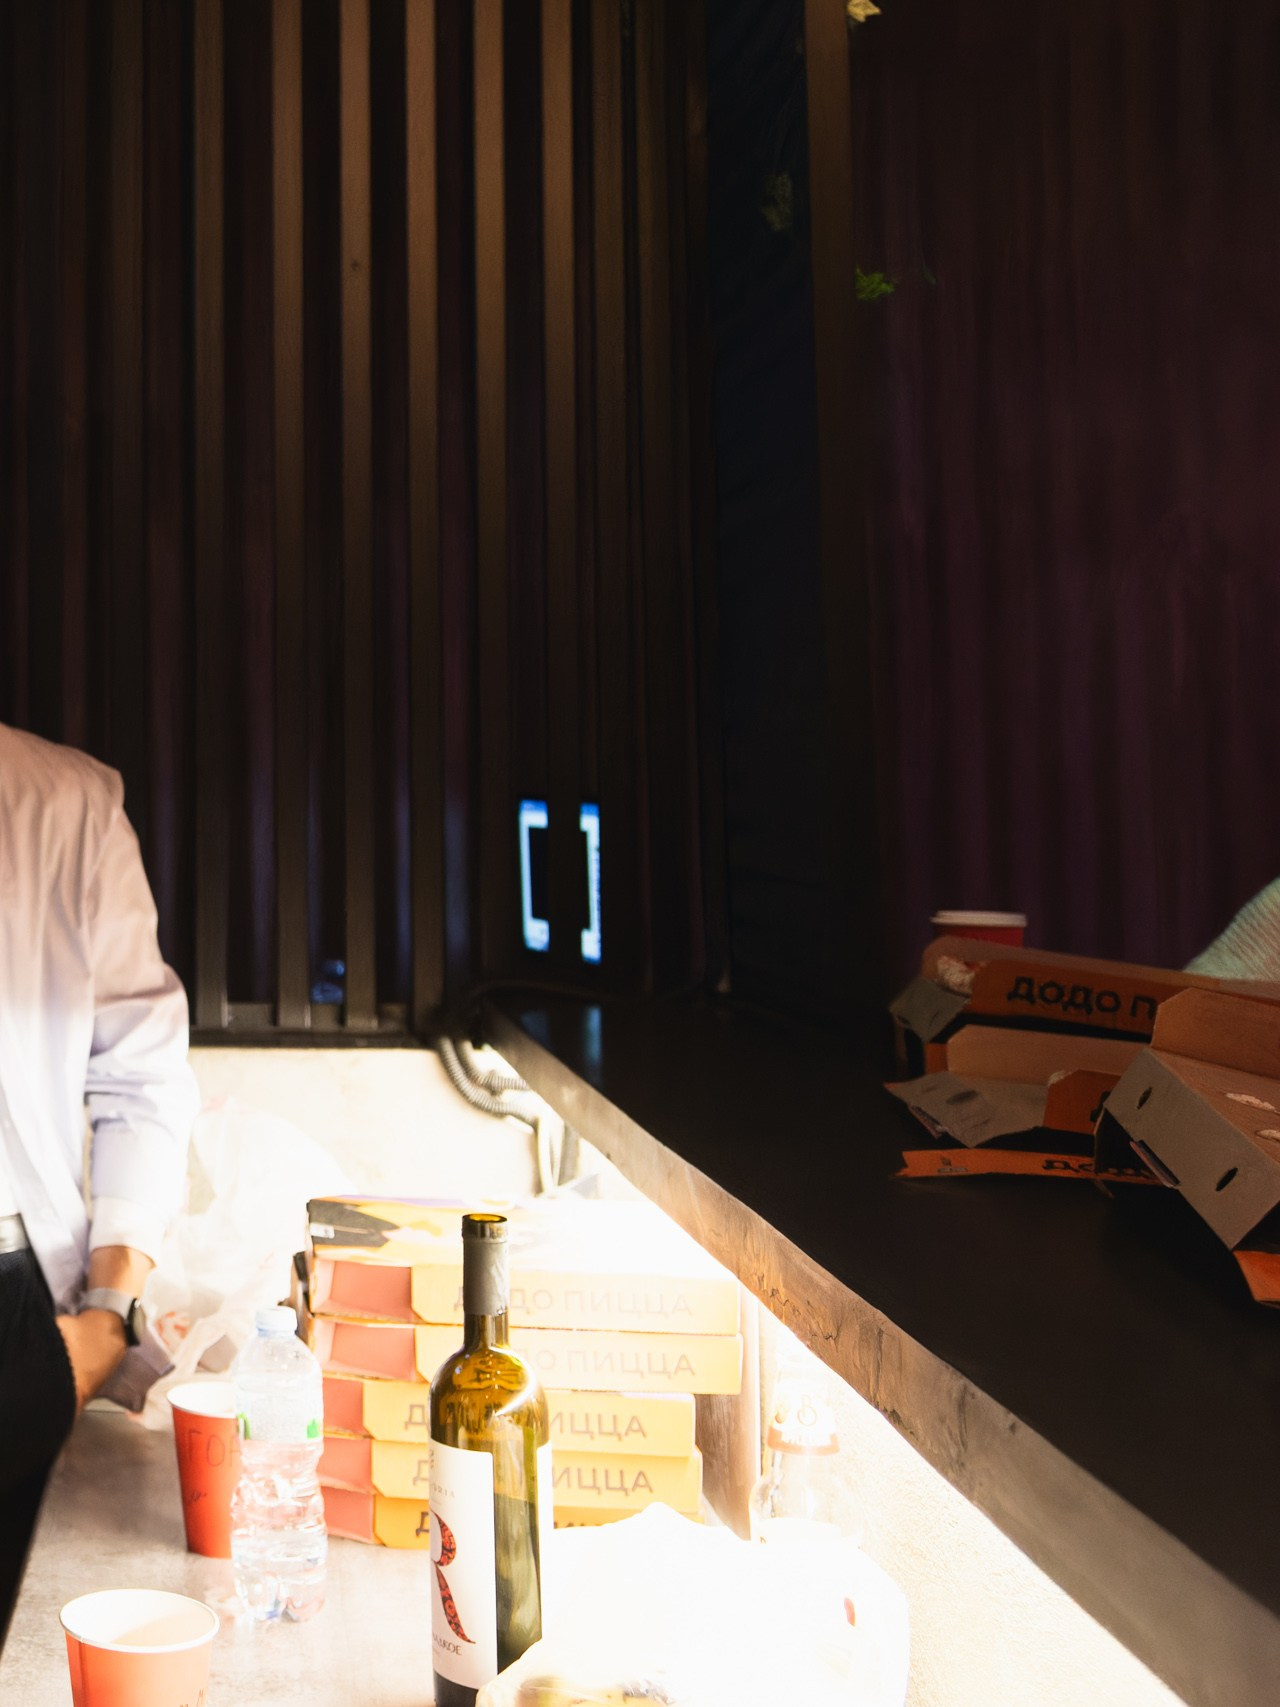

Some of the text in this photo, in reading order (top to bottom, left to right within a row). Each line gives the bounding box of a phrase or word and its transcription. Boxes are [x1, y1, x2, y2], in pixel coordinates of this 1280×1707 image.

[1007, 975, 1121, 1015] ДОДО
[564, 1290, 693, 1319] ПИЦЦА
[567, 1350, 697, 1380] ПИЦЦА
[550, 1411, 648, 1441] ИЦЦА
[552, 1467, 654, 1497] ИЦЦА
